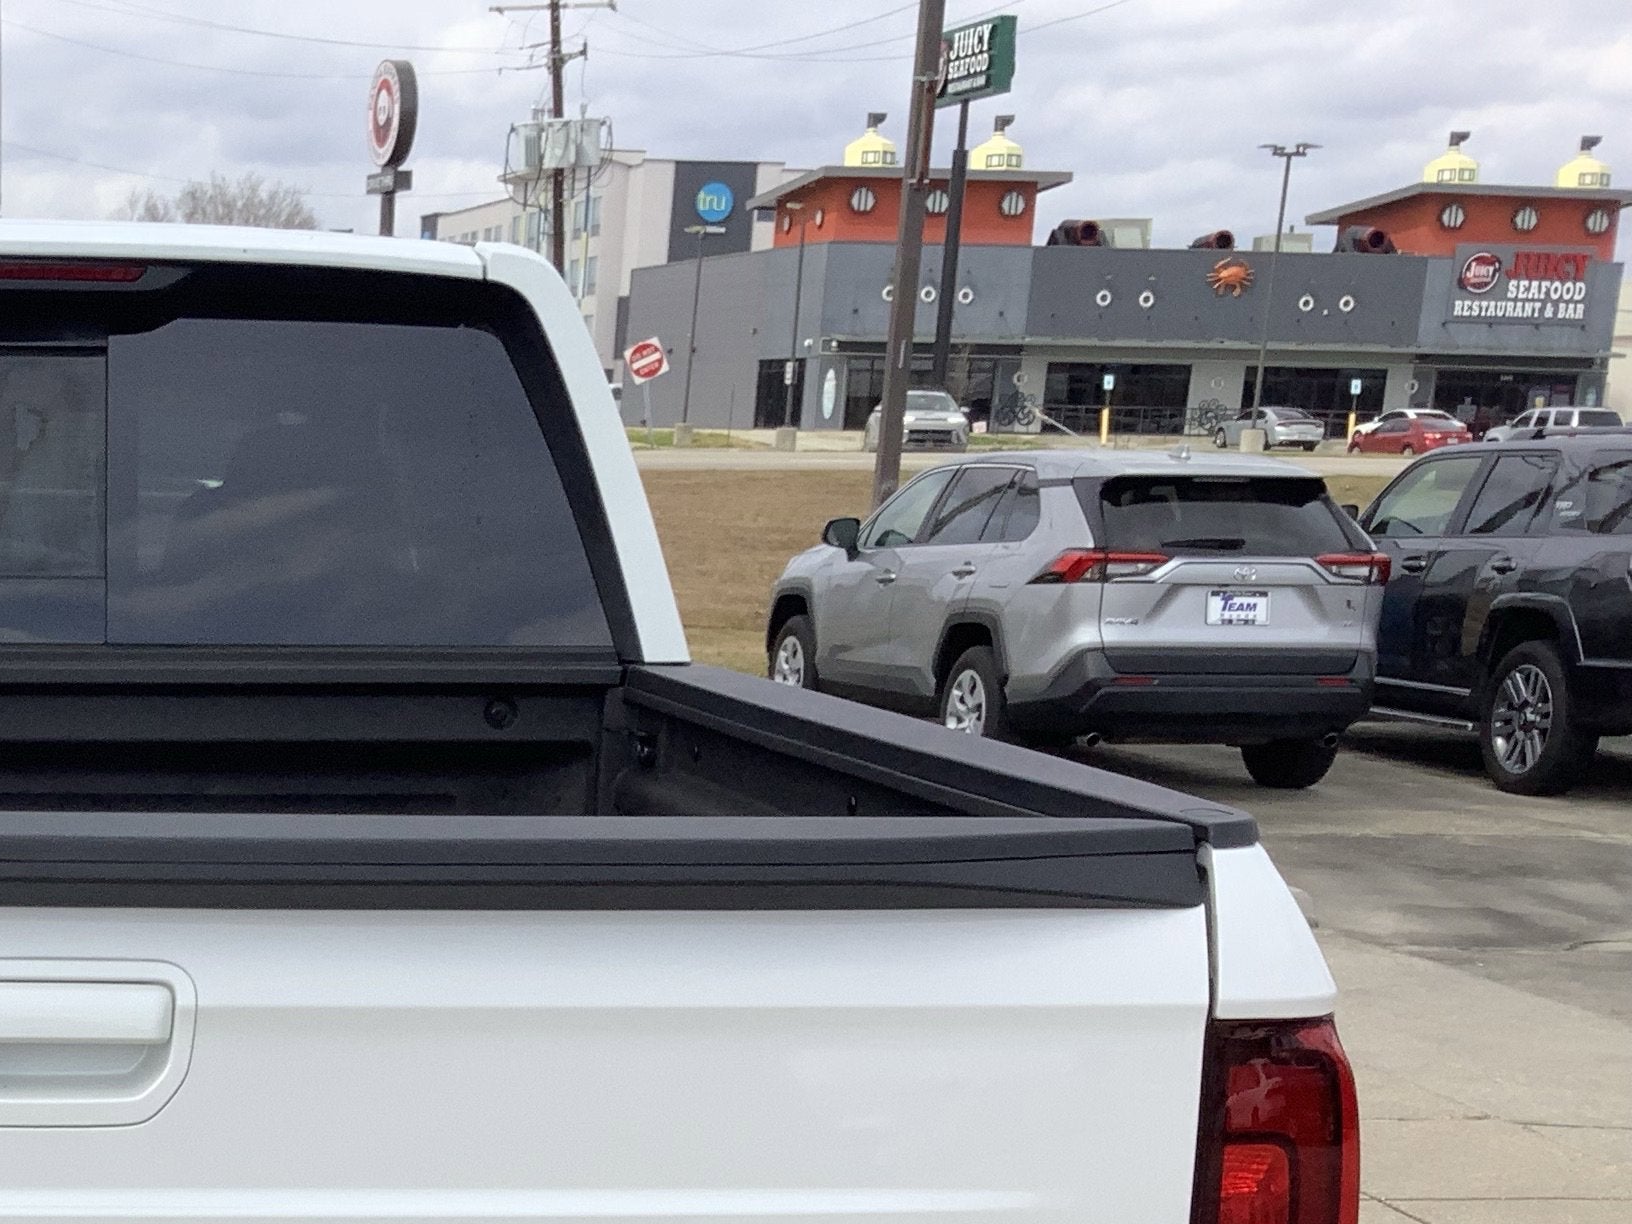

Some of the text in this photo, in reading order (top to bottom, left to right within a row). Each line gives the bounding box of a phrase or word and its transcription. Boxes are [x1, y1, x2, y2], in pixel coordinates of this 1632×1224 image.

[949, 23, 993, 60] JUICY
[948, 53, 989, 79] SEAFOOD
[698, 190, 725, 210] tru
[1505, 252, 1588, 281] JUICY
[1507, 280, 1586, 300] SEAFOOD
[1453, 300, 1585, 319] RESTAURANT & BAR
[1220, 593, 1257, 611] TEAM
